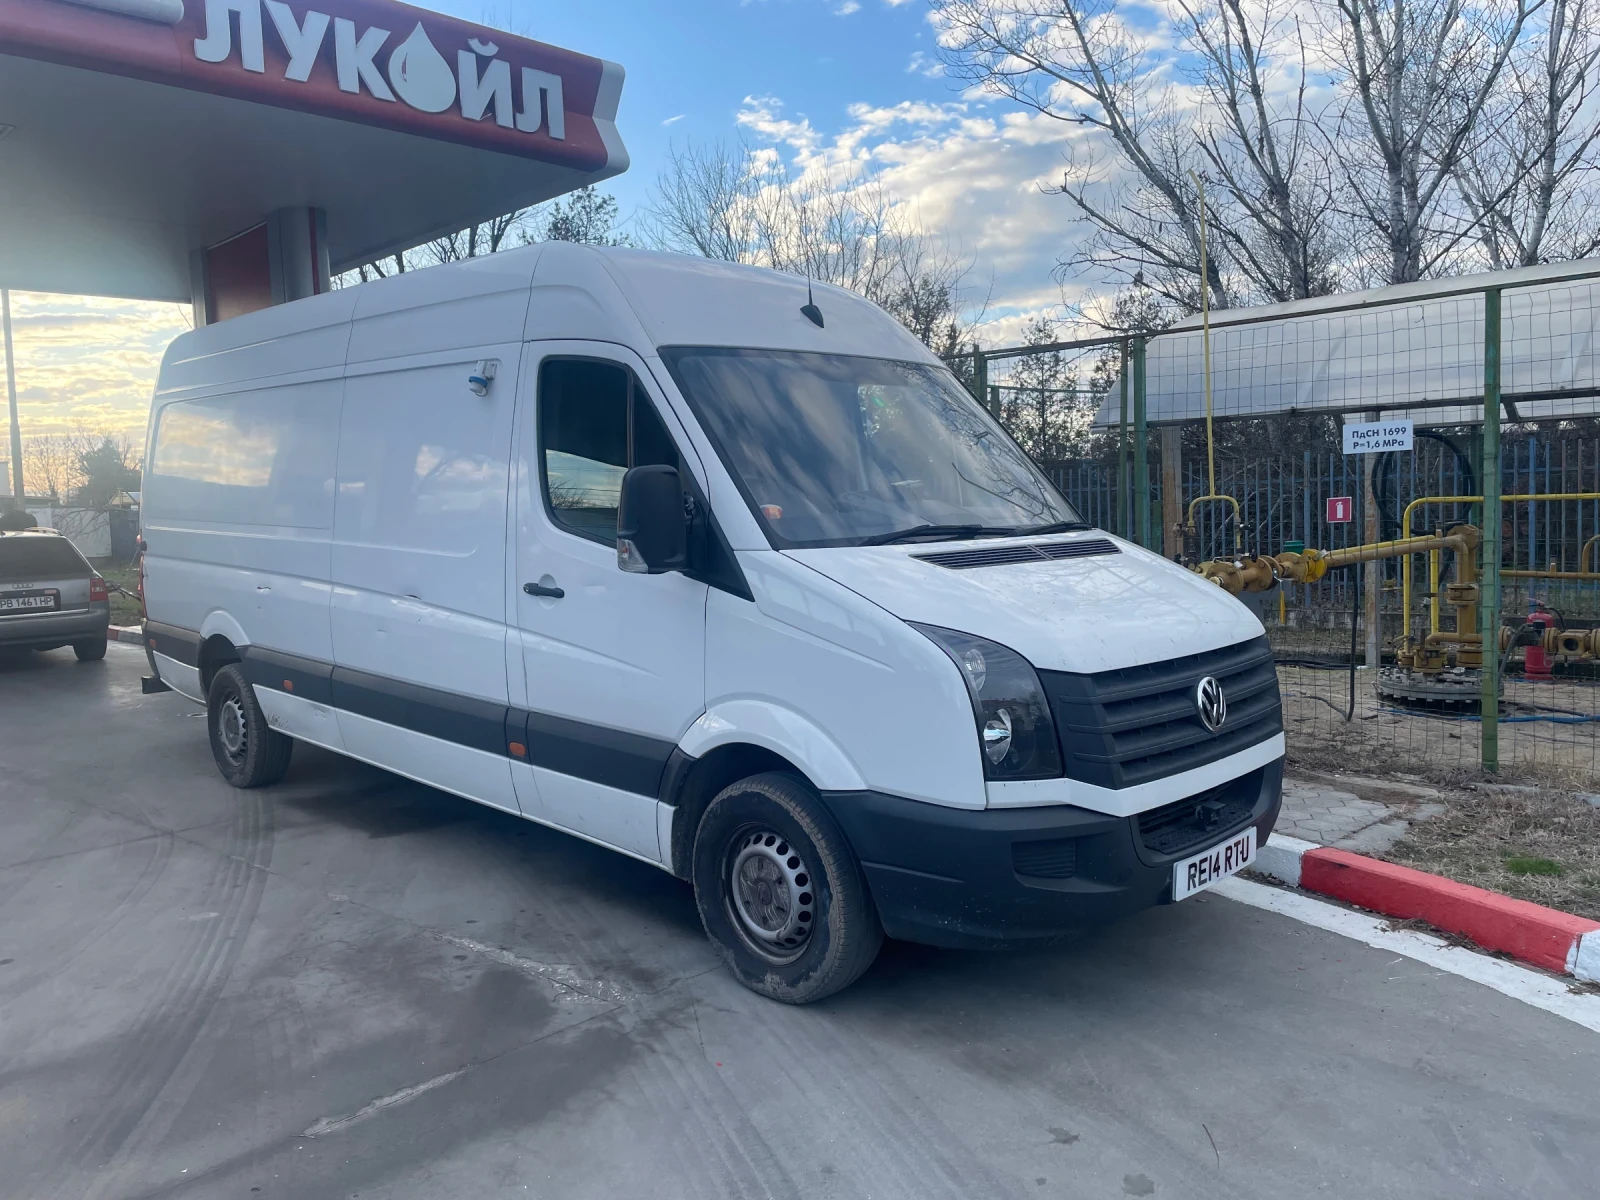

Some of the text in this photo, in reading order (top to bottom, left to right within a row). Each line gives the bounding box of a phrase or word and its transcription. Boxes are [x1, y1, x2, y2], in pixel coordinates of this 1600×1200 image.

[193, 0, 566, 140] ЛУКОЙЛ
[1383, 427, 1406, 436] 1699
[1382, 439, 1404, 447] MPa
[0, 597, 52, 608] PB 1461 HP
[1187, 835, 1249, 891] RE14 RTU
